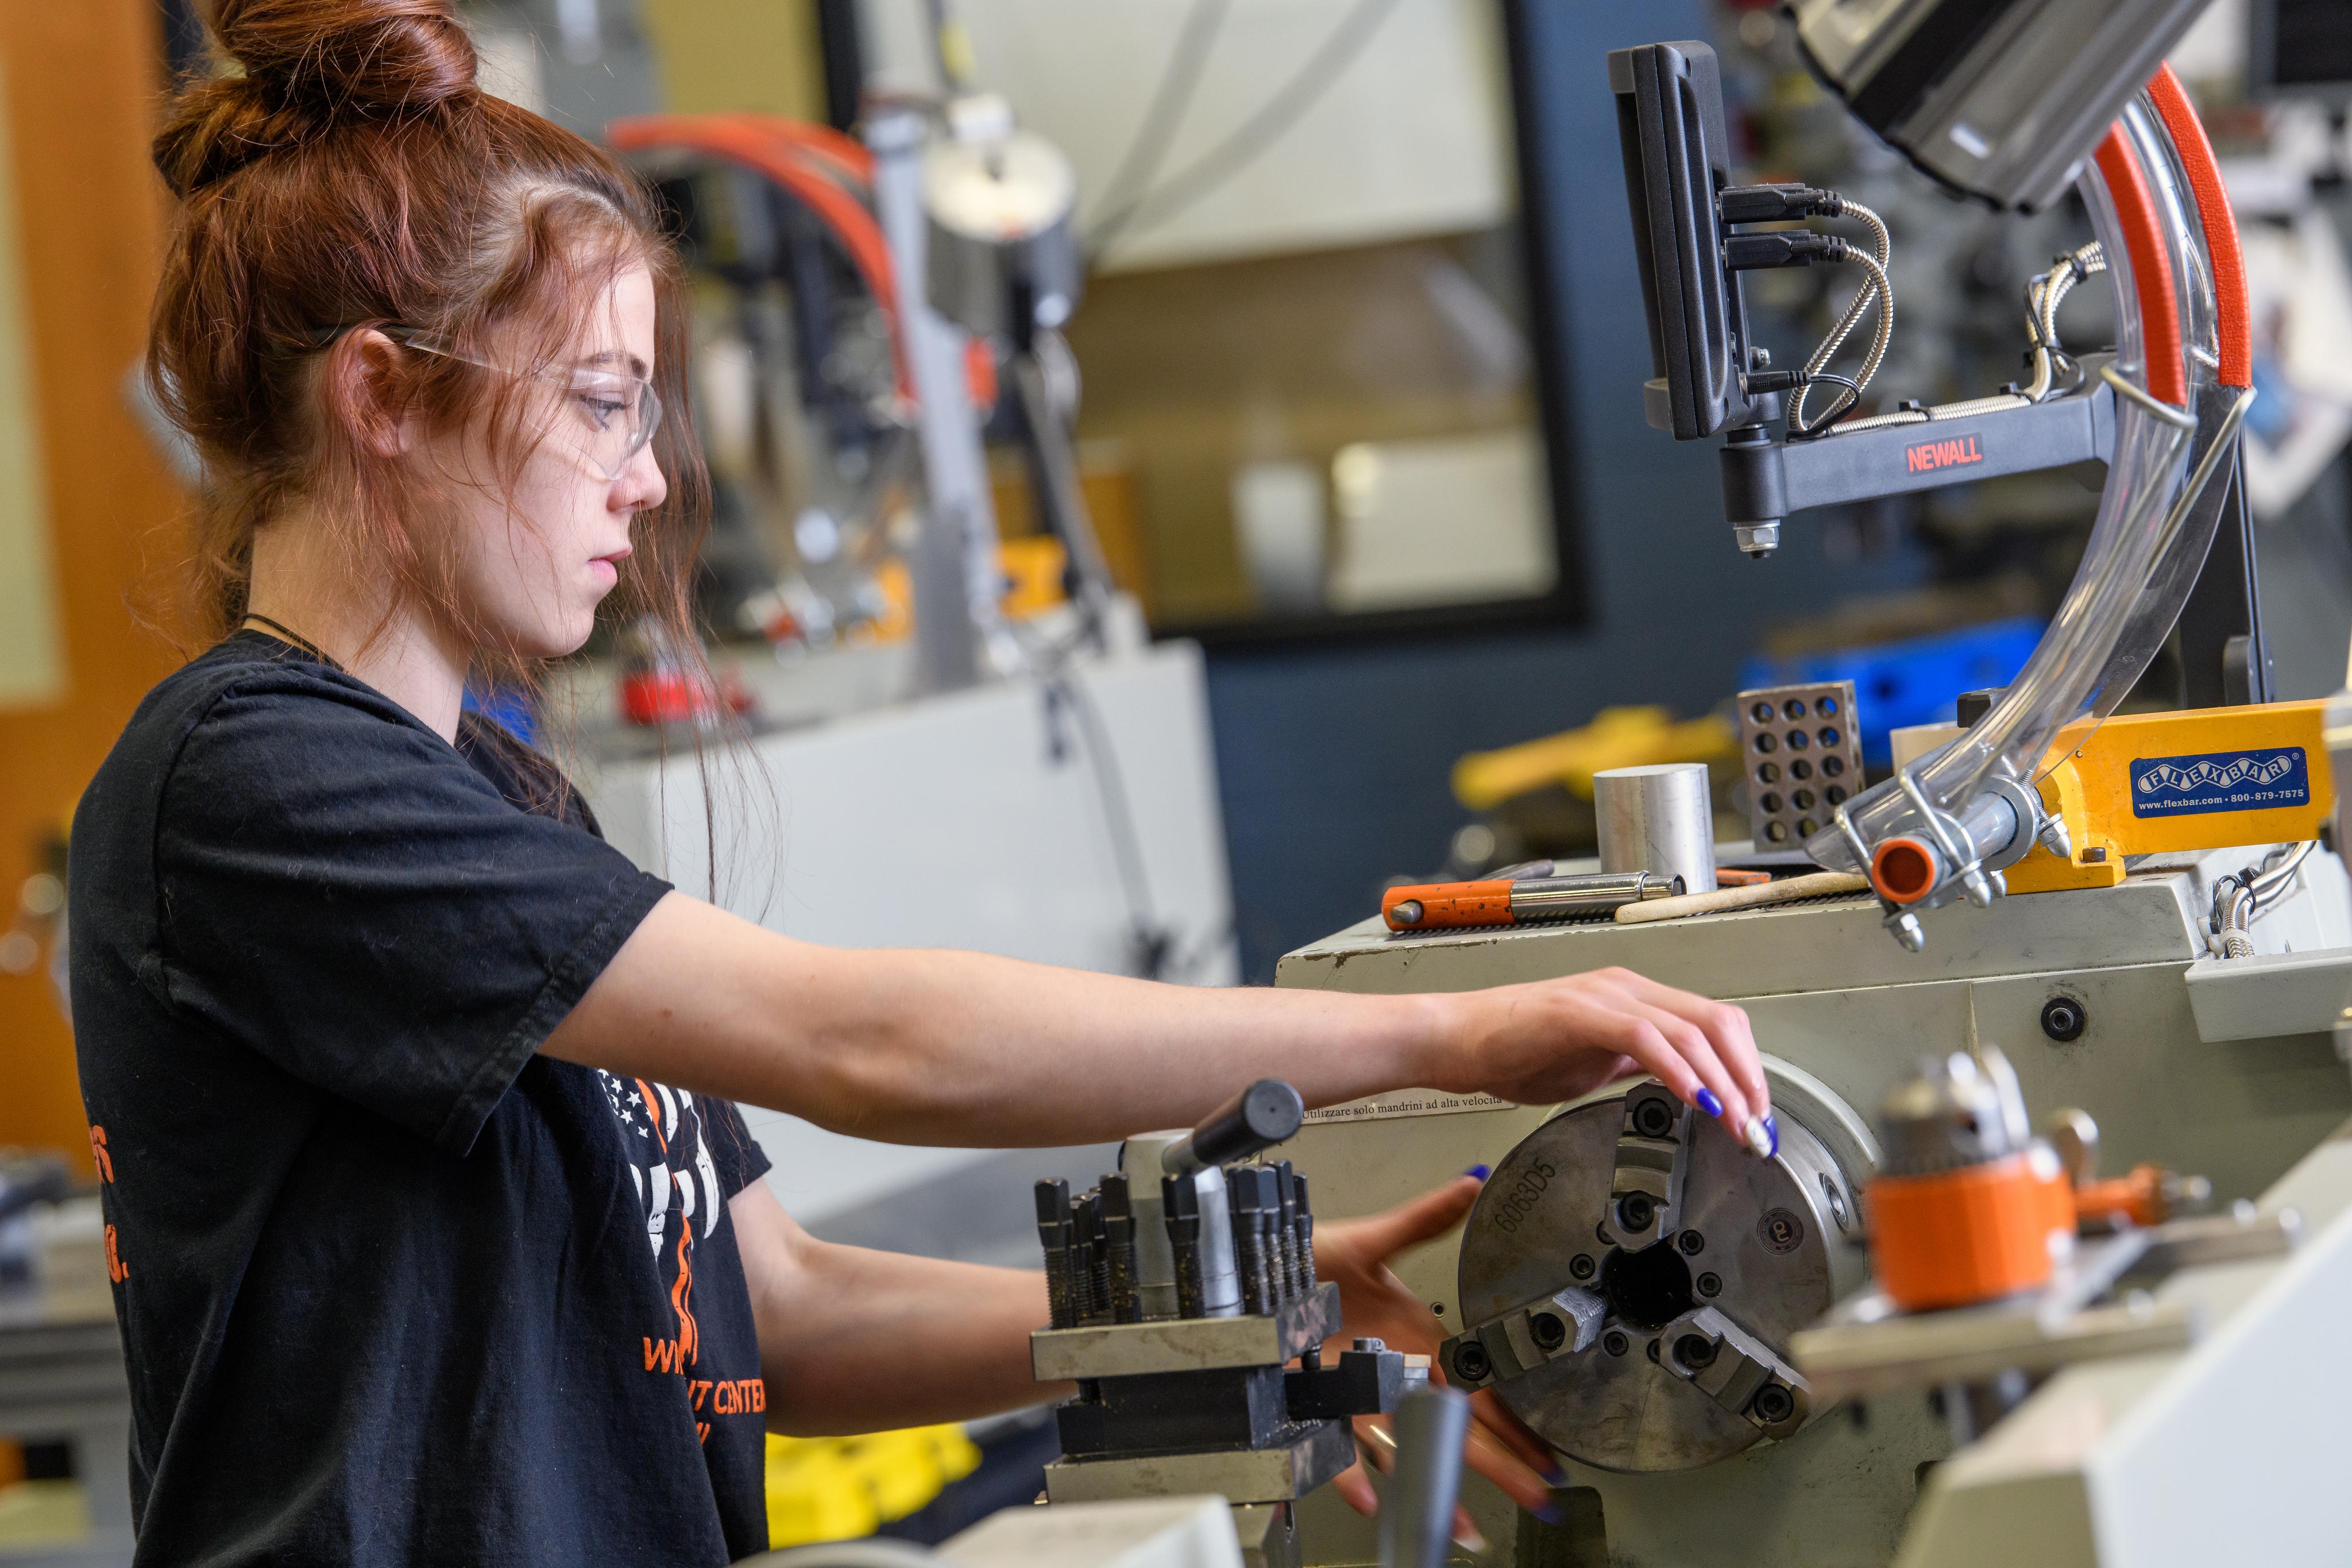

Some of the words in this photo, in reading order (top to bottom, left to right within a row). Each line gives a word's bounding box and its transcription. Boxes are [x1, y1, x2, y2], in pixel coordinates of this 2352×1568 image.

[1907, 437, 1983, 473] NEWALL
[2150, 763, 2281, 787] FLEXBAR
[2139, 798, 2222, 810] www.flexbar.com
[2231, 789, 2304, 802] 800-879-7575
[1303, 1108, 1350, 1119] Utilizzare
[1354, 1104, 1374, 1115] solo
[1378, 1100, 1422, 1113] mandrini
[1426, 1099, 1438, 1109] ad
[1441, 1098, 1459, 1108] alta
[1494, 1157, 1556, 1233] 6063D5
